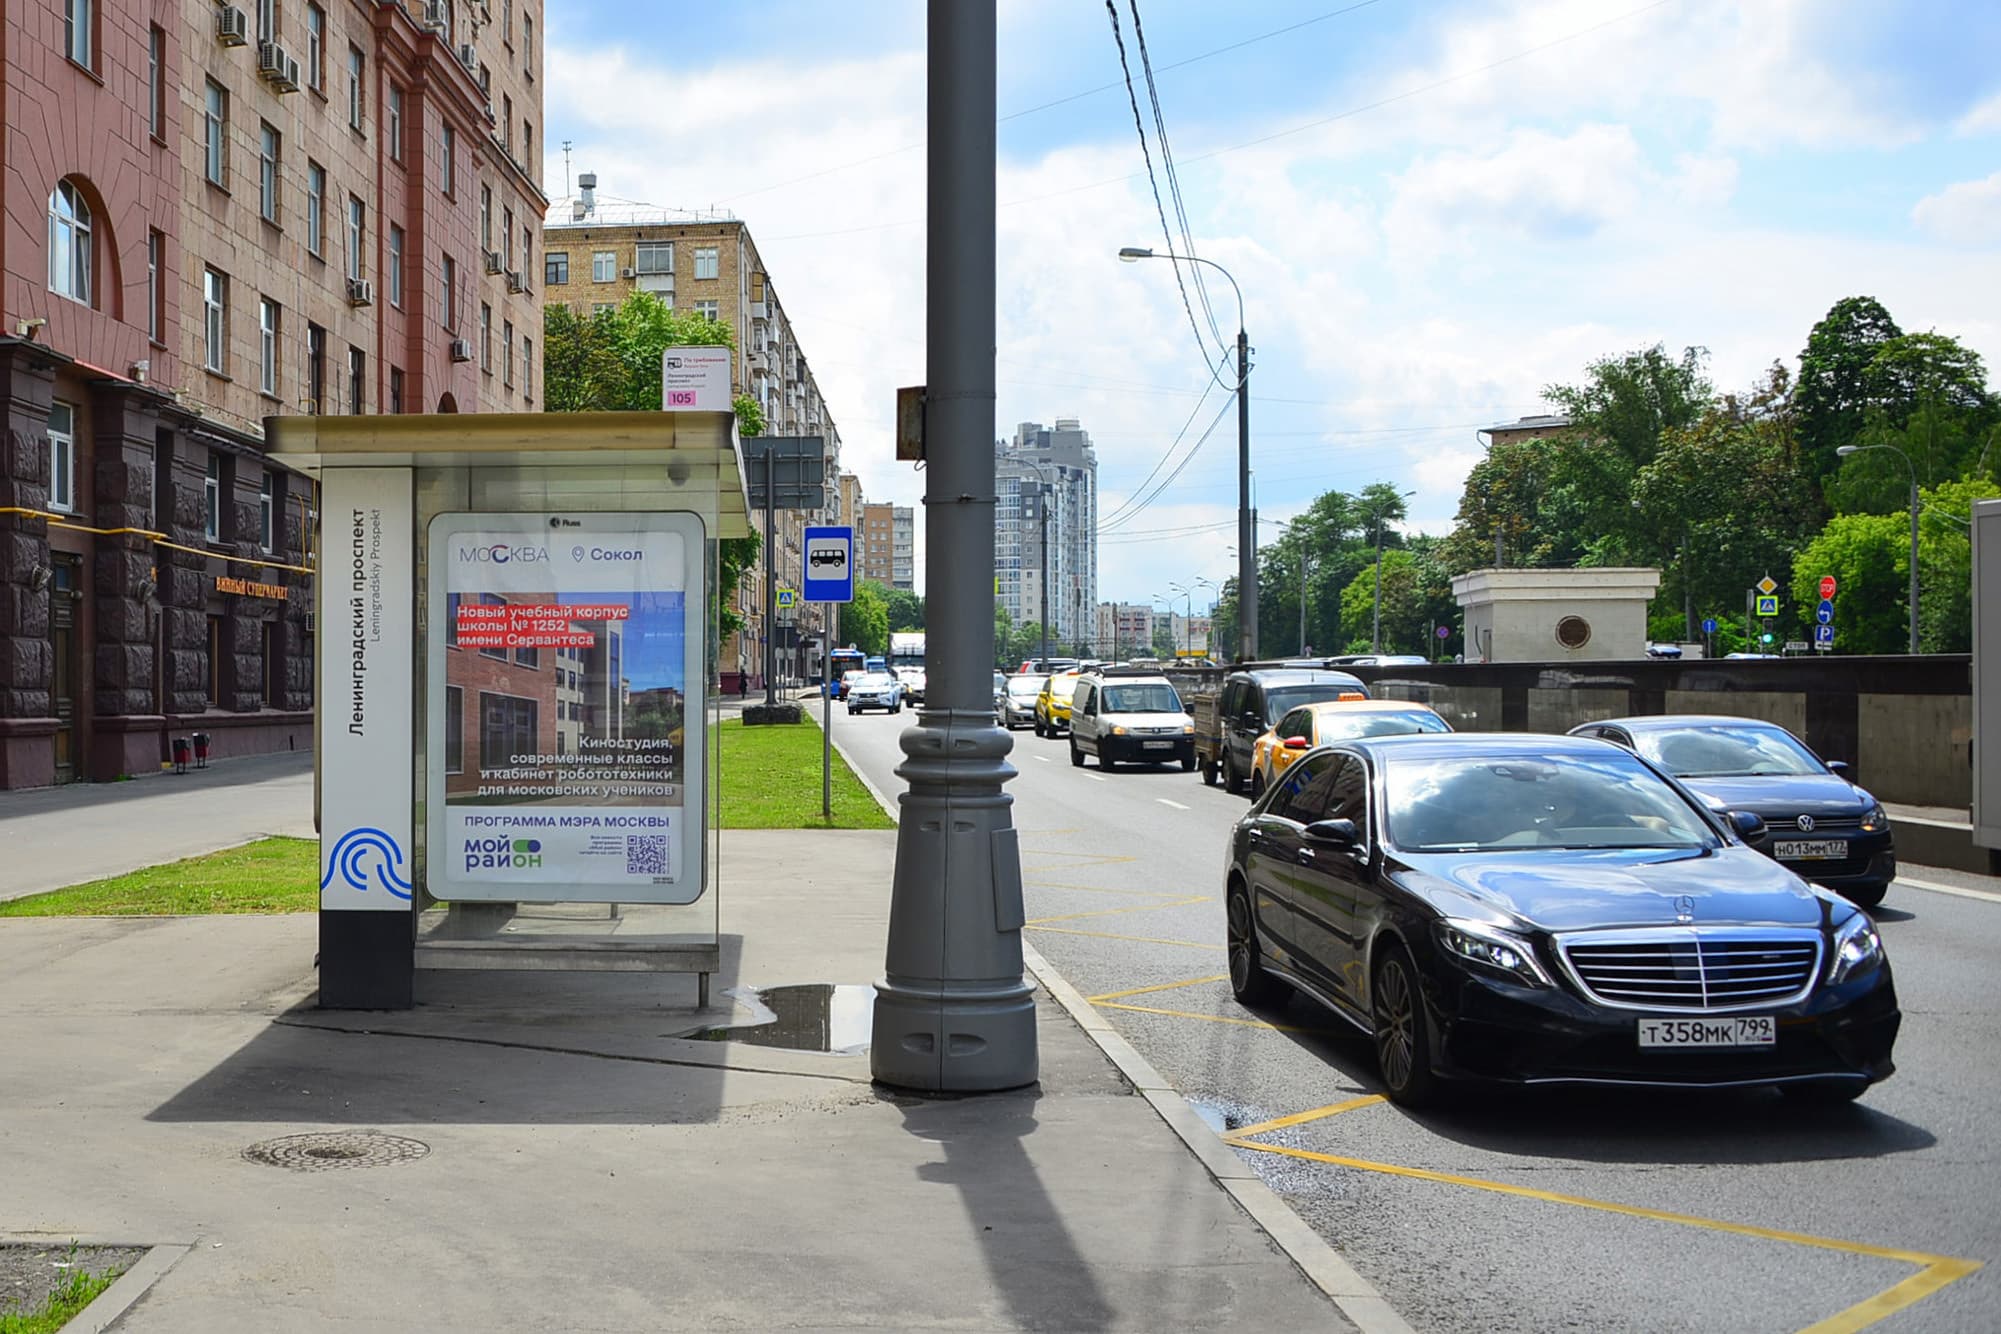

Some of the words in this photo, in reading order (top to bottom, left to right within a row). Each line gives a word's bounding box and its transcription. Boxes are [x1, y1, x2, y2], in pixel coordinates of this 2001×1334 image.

[672, 393, 692, 404] 105
[370, 509, 383, 559] Prospekt
[352, 509, 367, 592] проспект
[460, 545, 549, 563] МОСКВА
[590, 548, 643, 560] Сокол
[370, 563, 383, 642] Leningradskiy
[457, 605, 505, 618] Новый
[510, 605, 572, 620] учебный
[576, 607, 628, 620] корпус
[457, 621, 507, 631] школы
[511, 620, 529, 631] №
[532, 620, 565, 631] 1252
[457, 635, 503, 646] имени
[507, 634, 594, 648] Сервантеса
[349, 598, 367, 736] Ленинградский
[579, 736, 673, 750] Киностудия,
[510, 754, 613, 766] современные
[617, 754, 672, 764] классы
[481, 771, 490, 780] и
[494, 768, 555, 780] кабинет
[559, 768, 673, 782] робототехники
[478, 785, 505, 797] для
[510, 785, 599, 796] московских
[602, 785, 673, 798] учеников
[464, 816, 556, 828] ПРОГРАММА
[560, 816, 601, 828] МЭРА
[604, 816, 670, 828] МОСКВЫ
[464, 834, 511, 853] мой
[1737, 1019, 1770, 1036] 799
